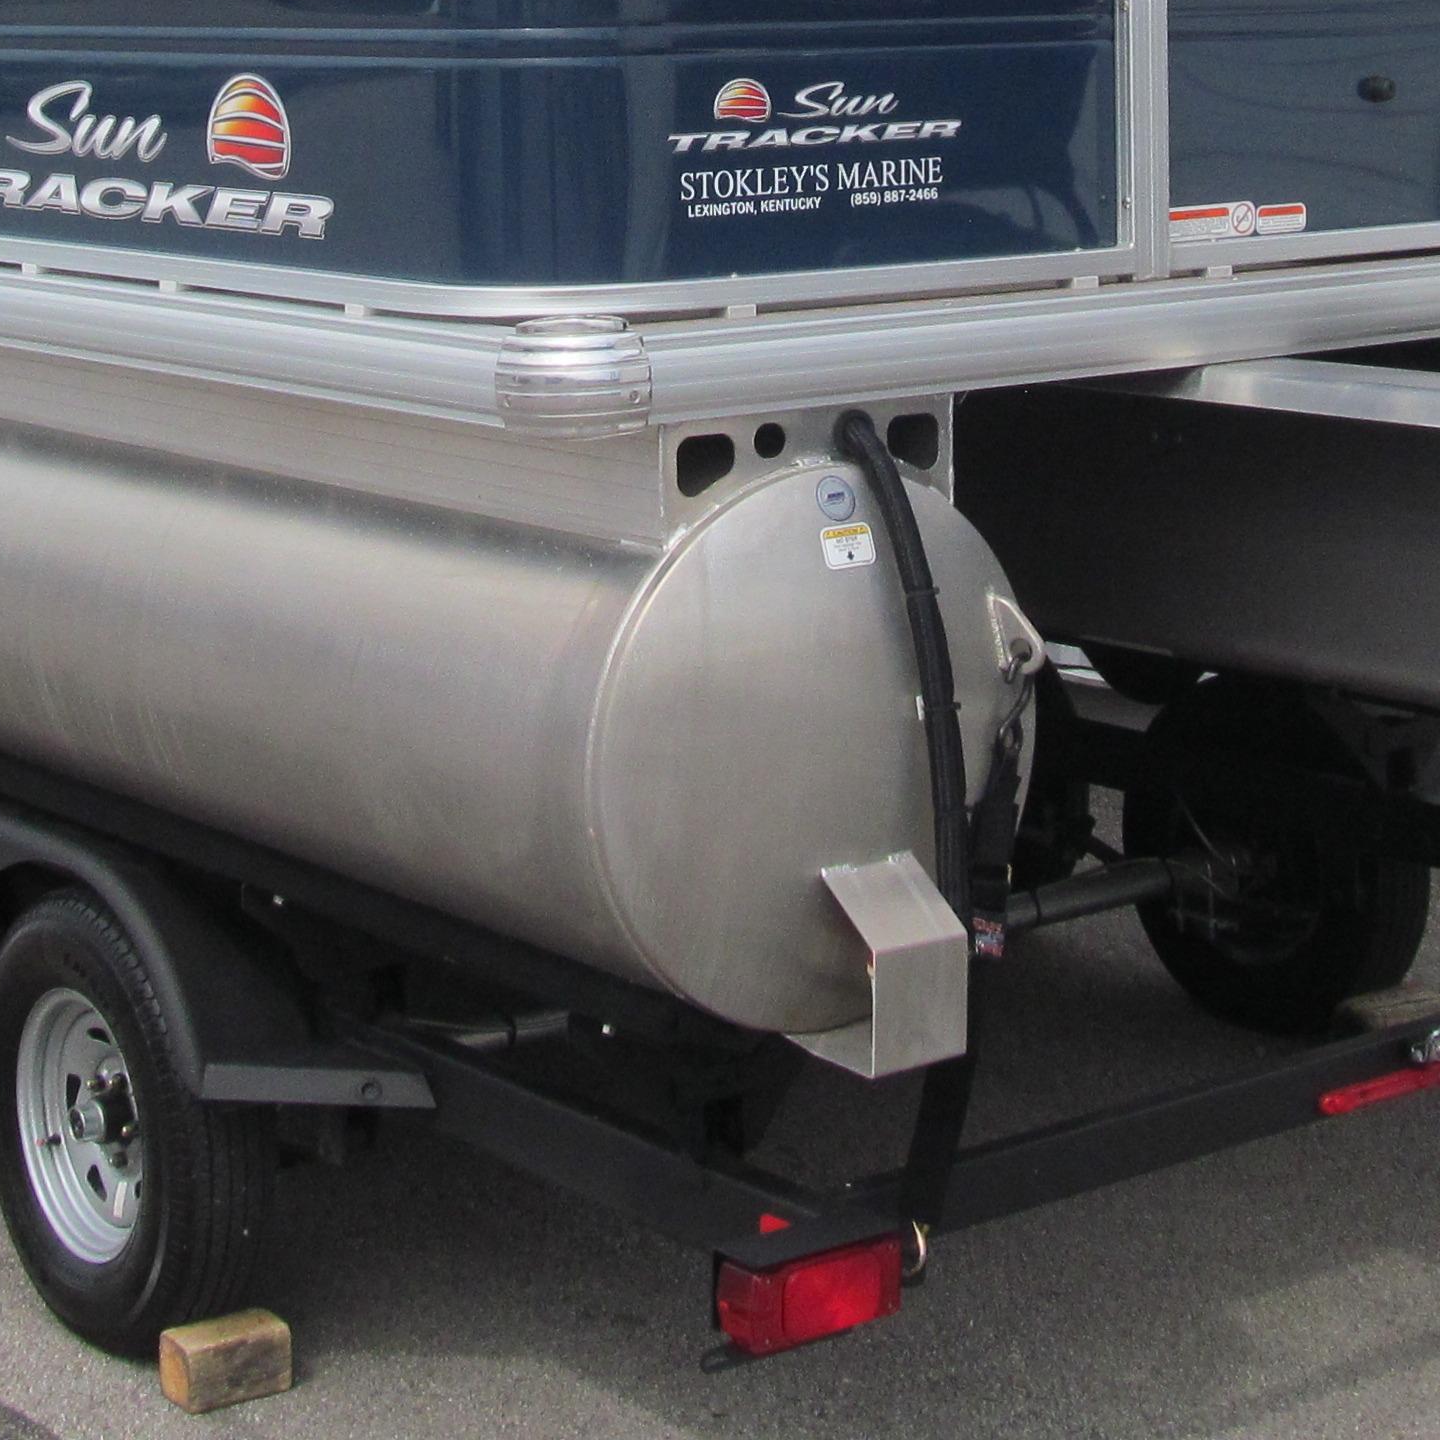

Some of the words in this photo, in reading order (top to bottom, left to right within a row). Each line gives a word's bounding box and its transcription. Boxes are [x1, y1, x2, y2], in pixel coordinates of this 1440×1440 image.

[776, 81, 900, 118] Sun
[5, 80, 168, 163] Sun
[666, 119, 963, 154] TRACKER
[680, 164, 830, 201] STOKLEY'S
[837, 157, 944, 191] MARINE
[687, 200, 758, 218] LEXINGTON,
[760, 196, 822, 213] KENTUCKY
[850, 193, 882, 207] (859)
[884, 187, 939, 203] 887-2466
